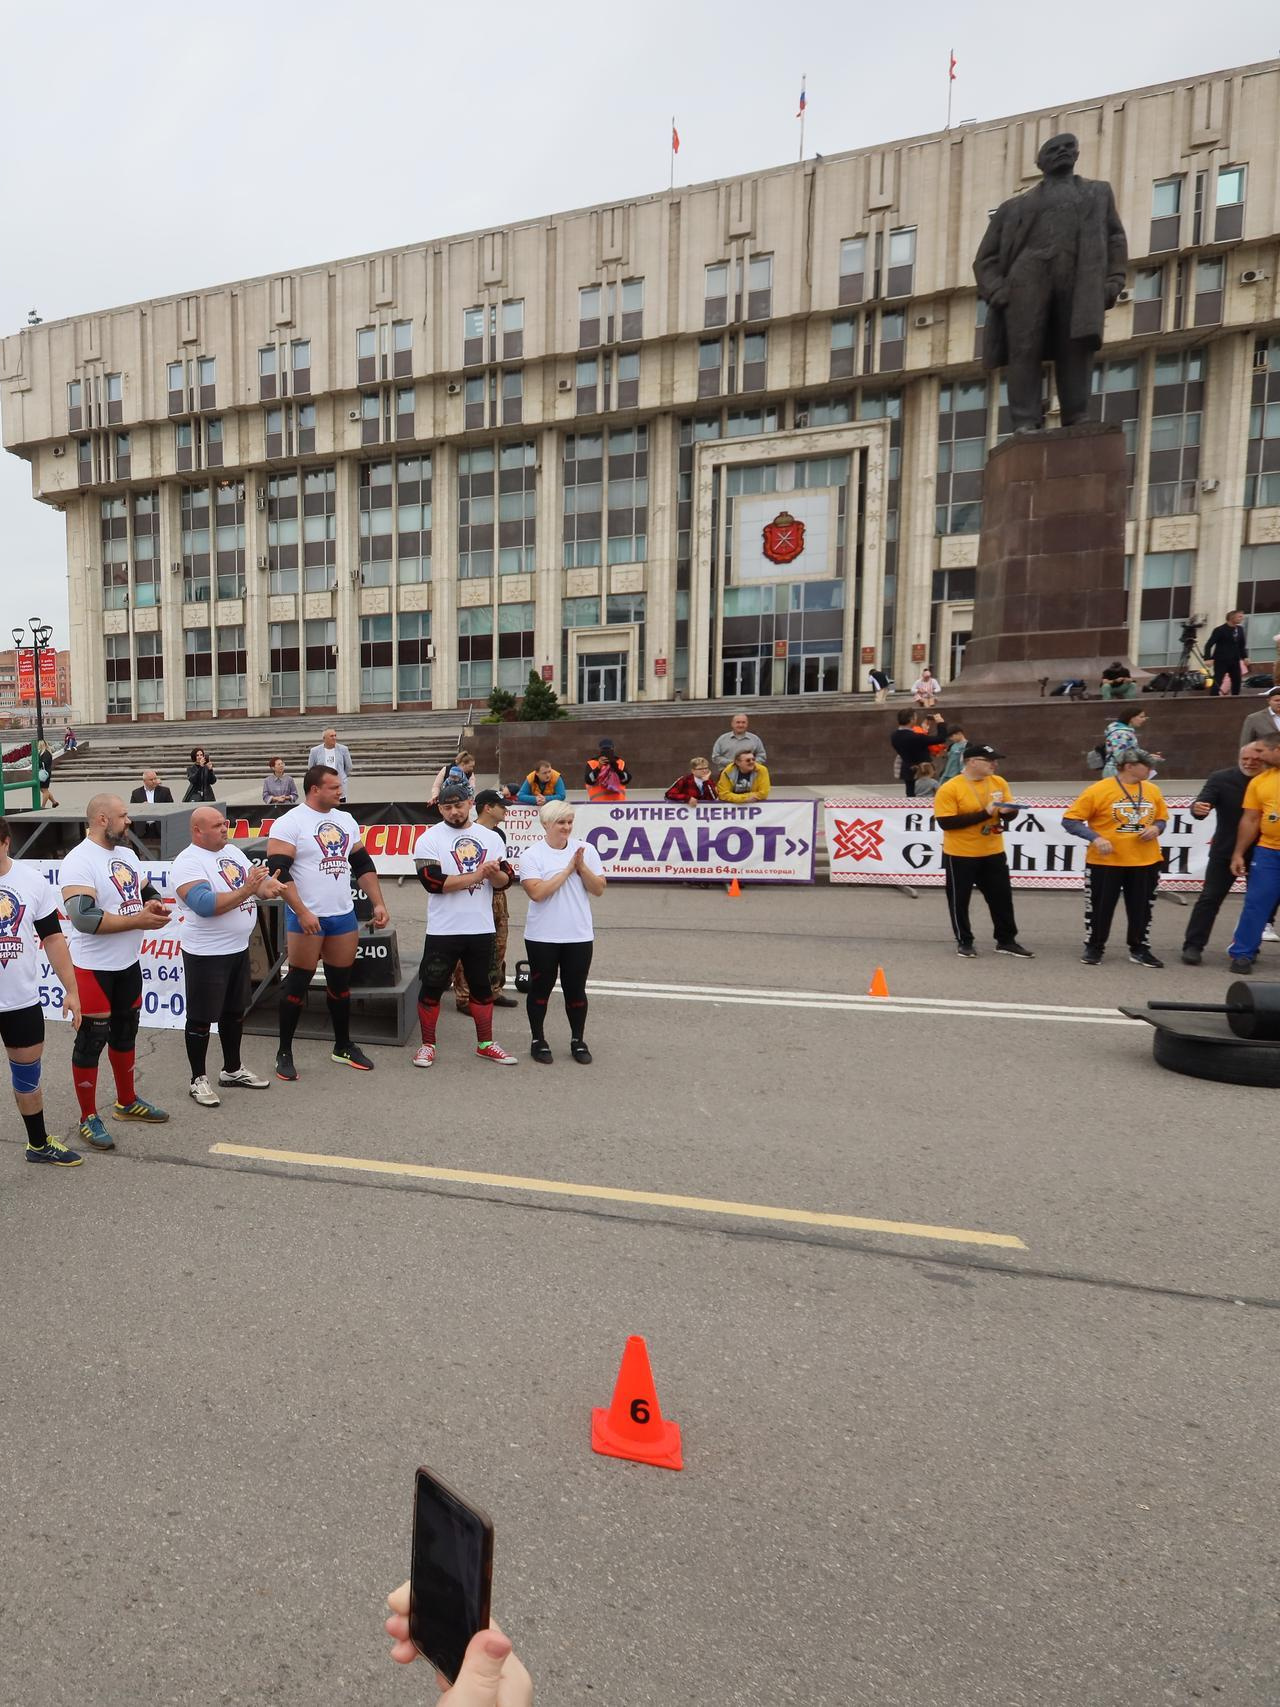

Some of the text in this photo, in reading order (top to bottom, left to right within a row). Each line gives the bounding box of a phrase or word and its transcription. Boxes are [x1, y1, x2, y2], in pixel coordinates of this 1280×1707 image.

[610, 807, 762, 823] ФИТНЕС ЦЕНТР
[612, 865, 661, 873] Николая
[665, 865, 714, 875] Руднева
[355, 945, 388, 959] 240
[518, 974, 529, 982] 24
[630, 1398, 650, 1424] 6
